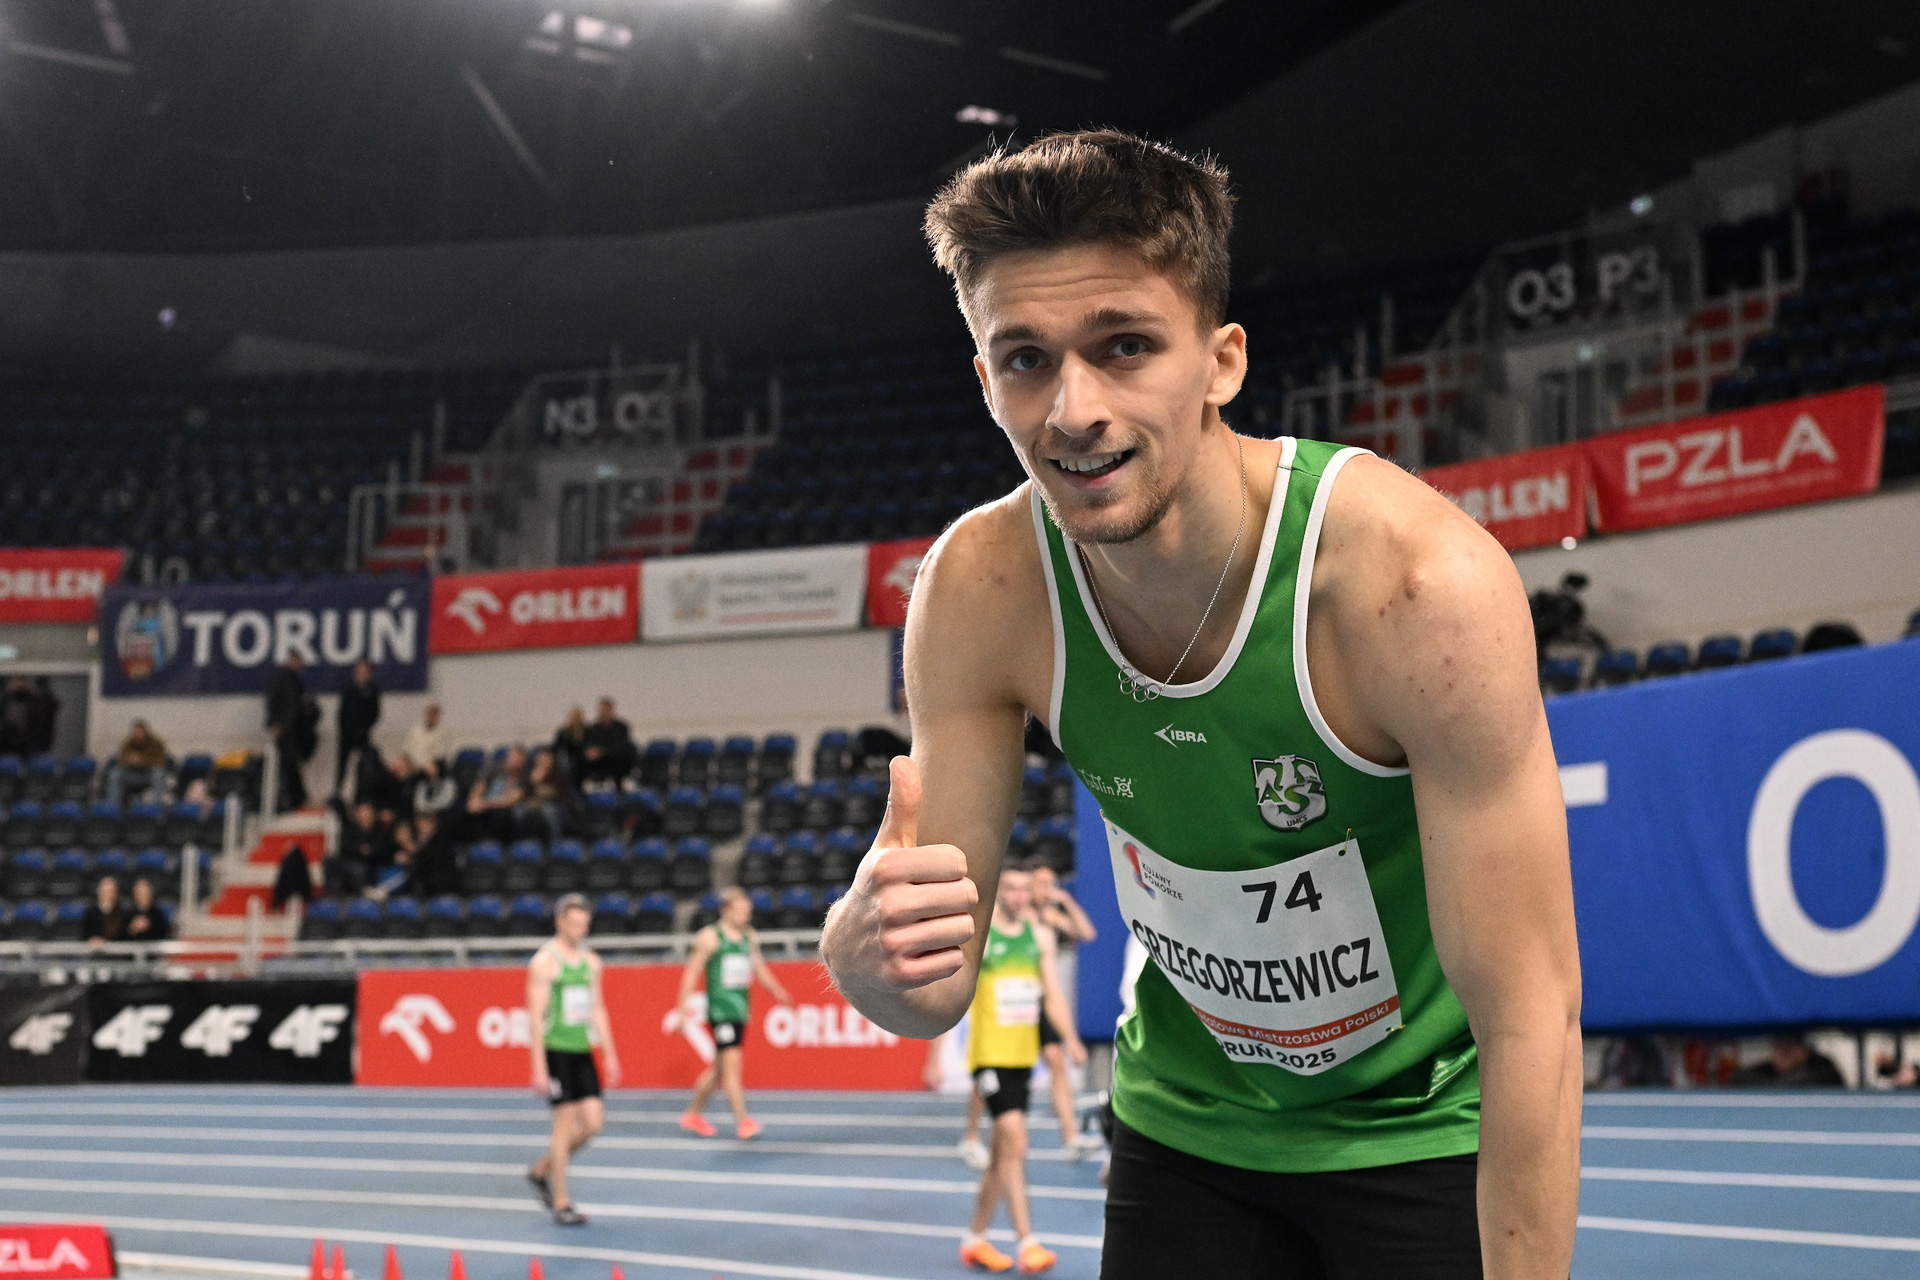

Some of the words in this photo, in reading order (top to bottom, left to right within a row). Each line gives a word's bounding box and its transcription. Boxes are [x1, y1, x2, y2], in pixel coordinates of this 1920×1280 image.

[1508, 263, 1575, 315] O3
[1624, 413, 1837, 497] PZLA
[1447, 471, 1569, 522] RLEN
[183, 590, 417, 667] TORUŃ
[510, 586, 626, 624] ORLEN
[1286, 814, 1309, 827] UMCS
[1142, 862, 1171, 886] KUJAWY
[1144, 872, 1184, 901] POMORZE
[1241, 870, 1324, 924] 74
[1132, 918, 1380, 1004] GRZEGORZEWICZ
[9, 1012, 74, 1055] 4F
[93, 1004, 173, 1057] 4F
[180, 1004, 261, 1057] 4F
[268, 1004, 350, 1058] 4F
[1248, 1026, 1341, 1045] Mistrzostwa
[1345, 1003, 1390, 1031] Polski
[1276, 1047, 1337, 1069] 2025
